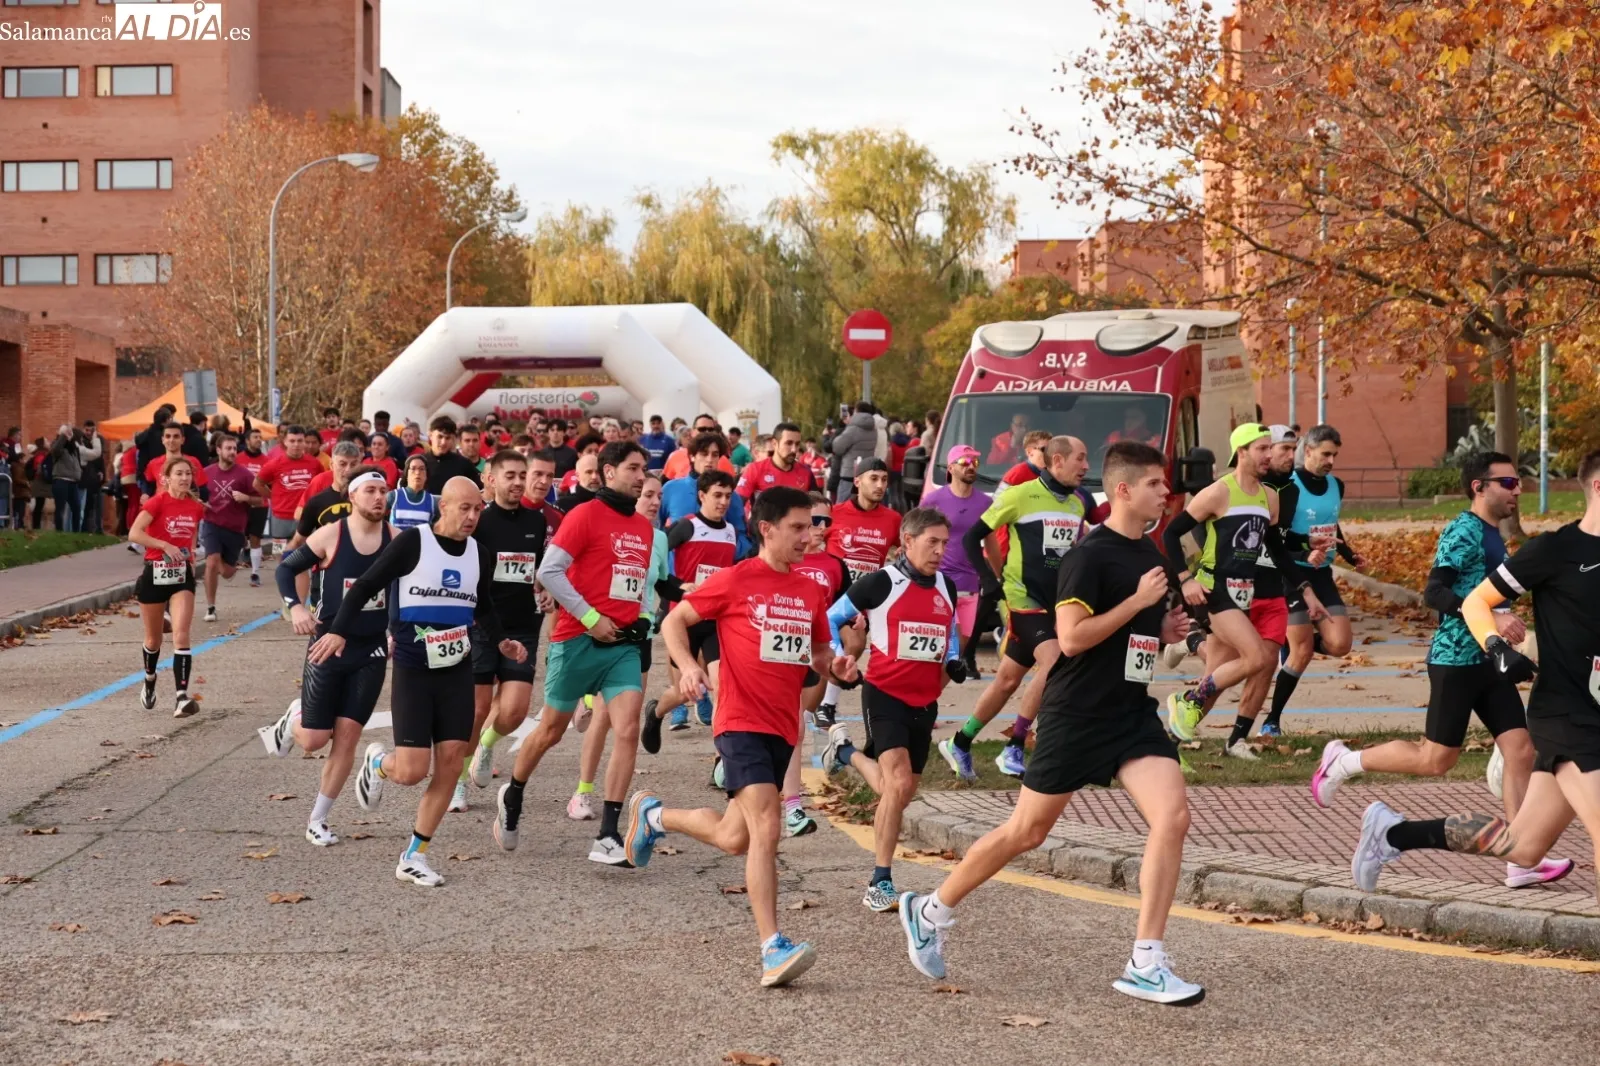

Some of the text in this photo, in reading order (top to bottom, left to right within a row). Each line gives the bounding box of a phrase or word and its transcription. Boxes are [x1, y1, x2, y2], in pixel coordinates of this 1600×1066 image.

[1052, 528, 1073, 540] 492
[160, 569, 180, 579] 285
[504, 562, 526, 575] 174
[614, 566, 646, 579] bedunia
[626, 578, 638, 592] 13
[1236, 590, 1248, 601] 43
[764, 621, 811, 635] bedunia
[900, 624, 945, 637] bedunia
[426, 628, 467, 644] bedunia
[437, 640, 464, 658] 363
[773, 635, 803, 653] 219
[909, 636, 937, 652] 276
